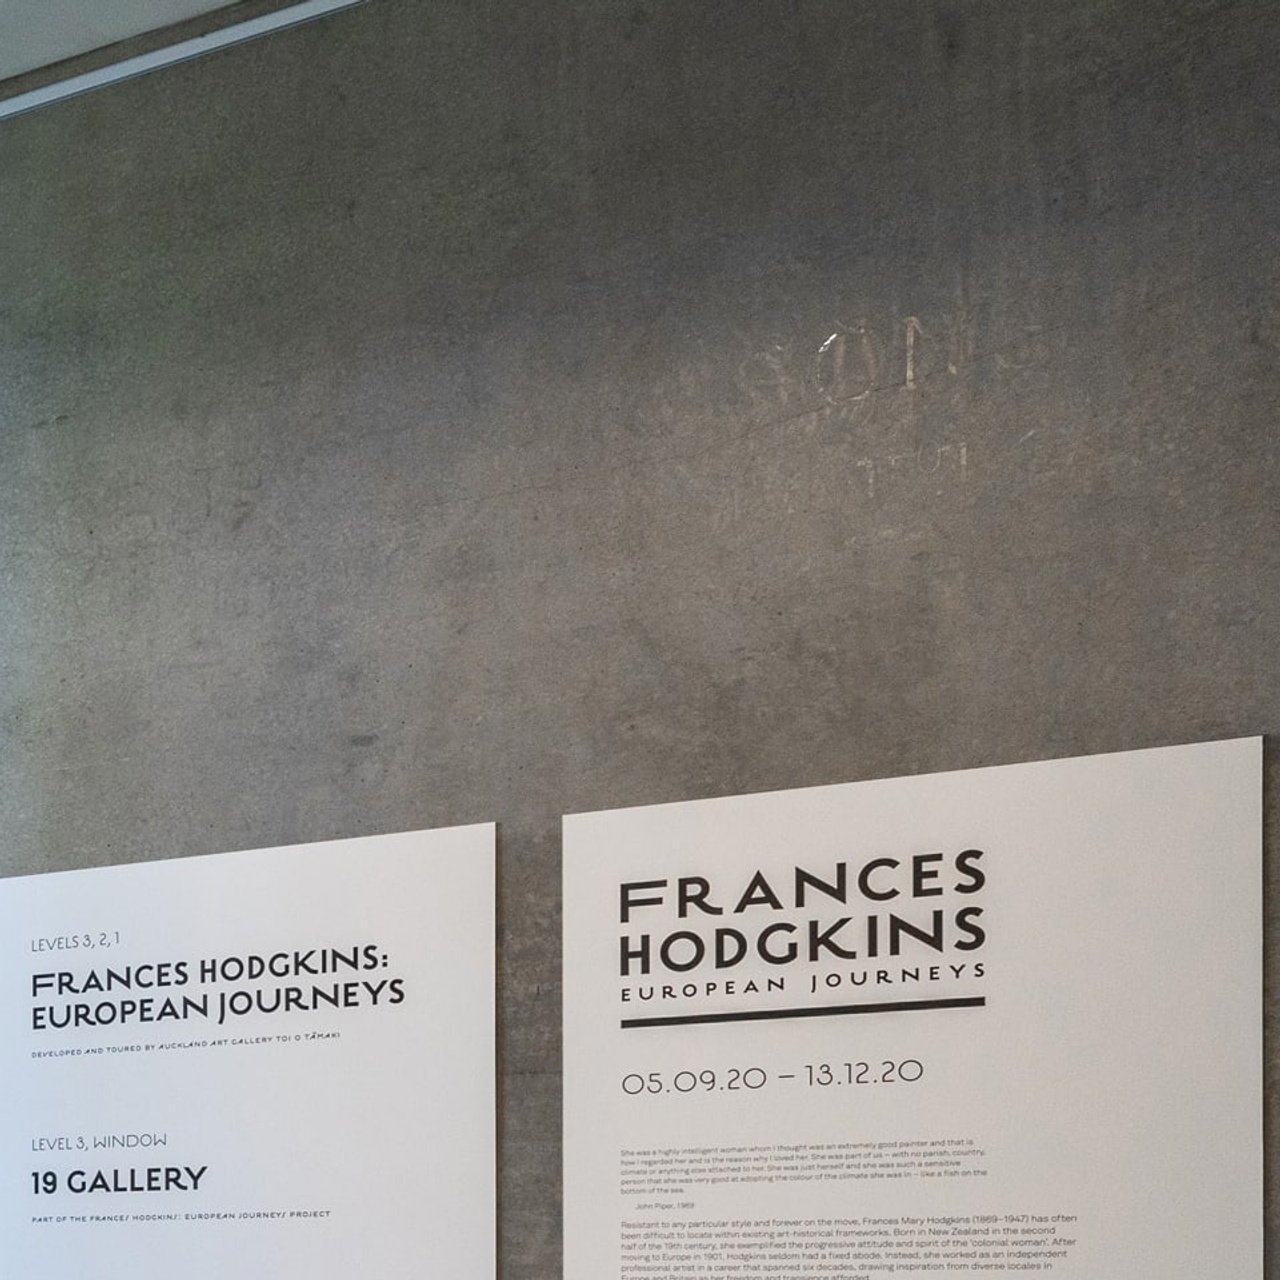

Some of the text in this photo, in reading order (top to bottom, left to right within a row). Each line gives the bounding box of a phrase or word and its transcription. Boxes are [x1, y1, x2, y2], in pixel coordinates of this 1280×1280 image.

[620, 848, 986, 924] FRANCES
[31, 931, 121, 953] LEVELS 3, 2, 1
[620, 905, 986, 977] HODGKINS
[32, 944, 389, 998] FRANCES HODGKINS:
[621, 963, 986, 1003] EUROPEAN JOURNEYS
[32, 978, 405, 1031] EUROPEAN JOURNEYS
[31, 1048, 83, 1059] DEVELOPED
[84, 1047, 104, 1055] AND
[106, 1044, 142, 1054] TOURED
[144, 1043, 156, 1052] BY
[157, 1040, 208, 1051] AUCKLAND
[210, 1039, 228, 1047] ART
[231, 1036, 274, 1046] GALLERY
[276, 1034, 292, 1043] TOI
[294, 1034, 302, 1042] O
[622, 1067, 767, 1096] 05.09.20
[805, 1059, 924, 1088] 13.12.20
[31, 1133, 168, 1152] LEVEL 3, WINDOW
[31, 1166, 209, 1195] 19 GALLERY
[132, 1214, 181, 1222] HODGKINS:
[184, 1212, 236, 1221] EUROPEAN
[238, 1211, 287, 1220] JOURNEYS
[289, 1210, 332, 1219] PROJECT
[621, 1220, 659, 1229] Resistant
[672, 1221, 686, 1229] any
[688, 1219, 729, 1229] particular
[731, 1219, 752, 1229] style
[754, 1219, 770, 1227] and
[772, 1218, 802, 1227] forever
[817, 1218, 832, 1226] the
[862, 1217, 899, 1225] Frances
[901, 1216, 925, 1226] Mary
[926, 1216, 970, 1226] Hodgkins
[972, 1215, 1029, 1224] (1869–1947)
[1031, 1214, 1049, 1223] has
[1051, 1214, 1077, 1223] often
[620, 1231, 641, 1239] been
[643, 1231, 675, 1239] difficult
[687, 1230, 713, 1239] locate
[714, 1230, 740, 1238] within
[742, 1230, 775, 1239] existing
[777, 1229, 833, 1238] art-historical
[835, 1228, 891, 1237] frameworks.
[893, 1228, 915, 1236] Born
[928, 1227, 949, 1236] New
[951, 1227, 990, 1236] Zealand
[1002, 1227, 1019, 1235] the
[1021, 1226, 1056, 1235] second
[620, 1263, 671, 1273] professional
[673, 1263, 695, 1271] artist
[743, 1263, 761, 1271] that
[763, 1263, 800, 1272] spanned
[802, 1263, 814, 1271] six
[816, 1263, 857, 1271] decades,
[858, 1262, 894, 1272] drawing
[896, 1262, 945, 1272] inspiration
[946, 1262, 969, 1270] from
[971, 1262, 1005, 1270] diverse
[1007, 1262, 1041, 1270] locales
